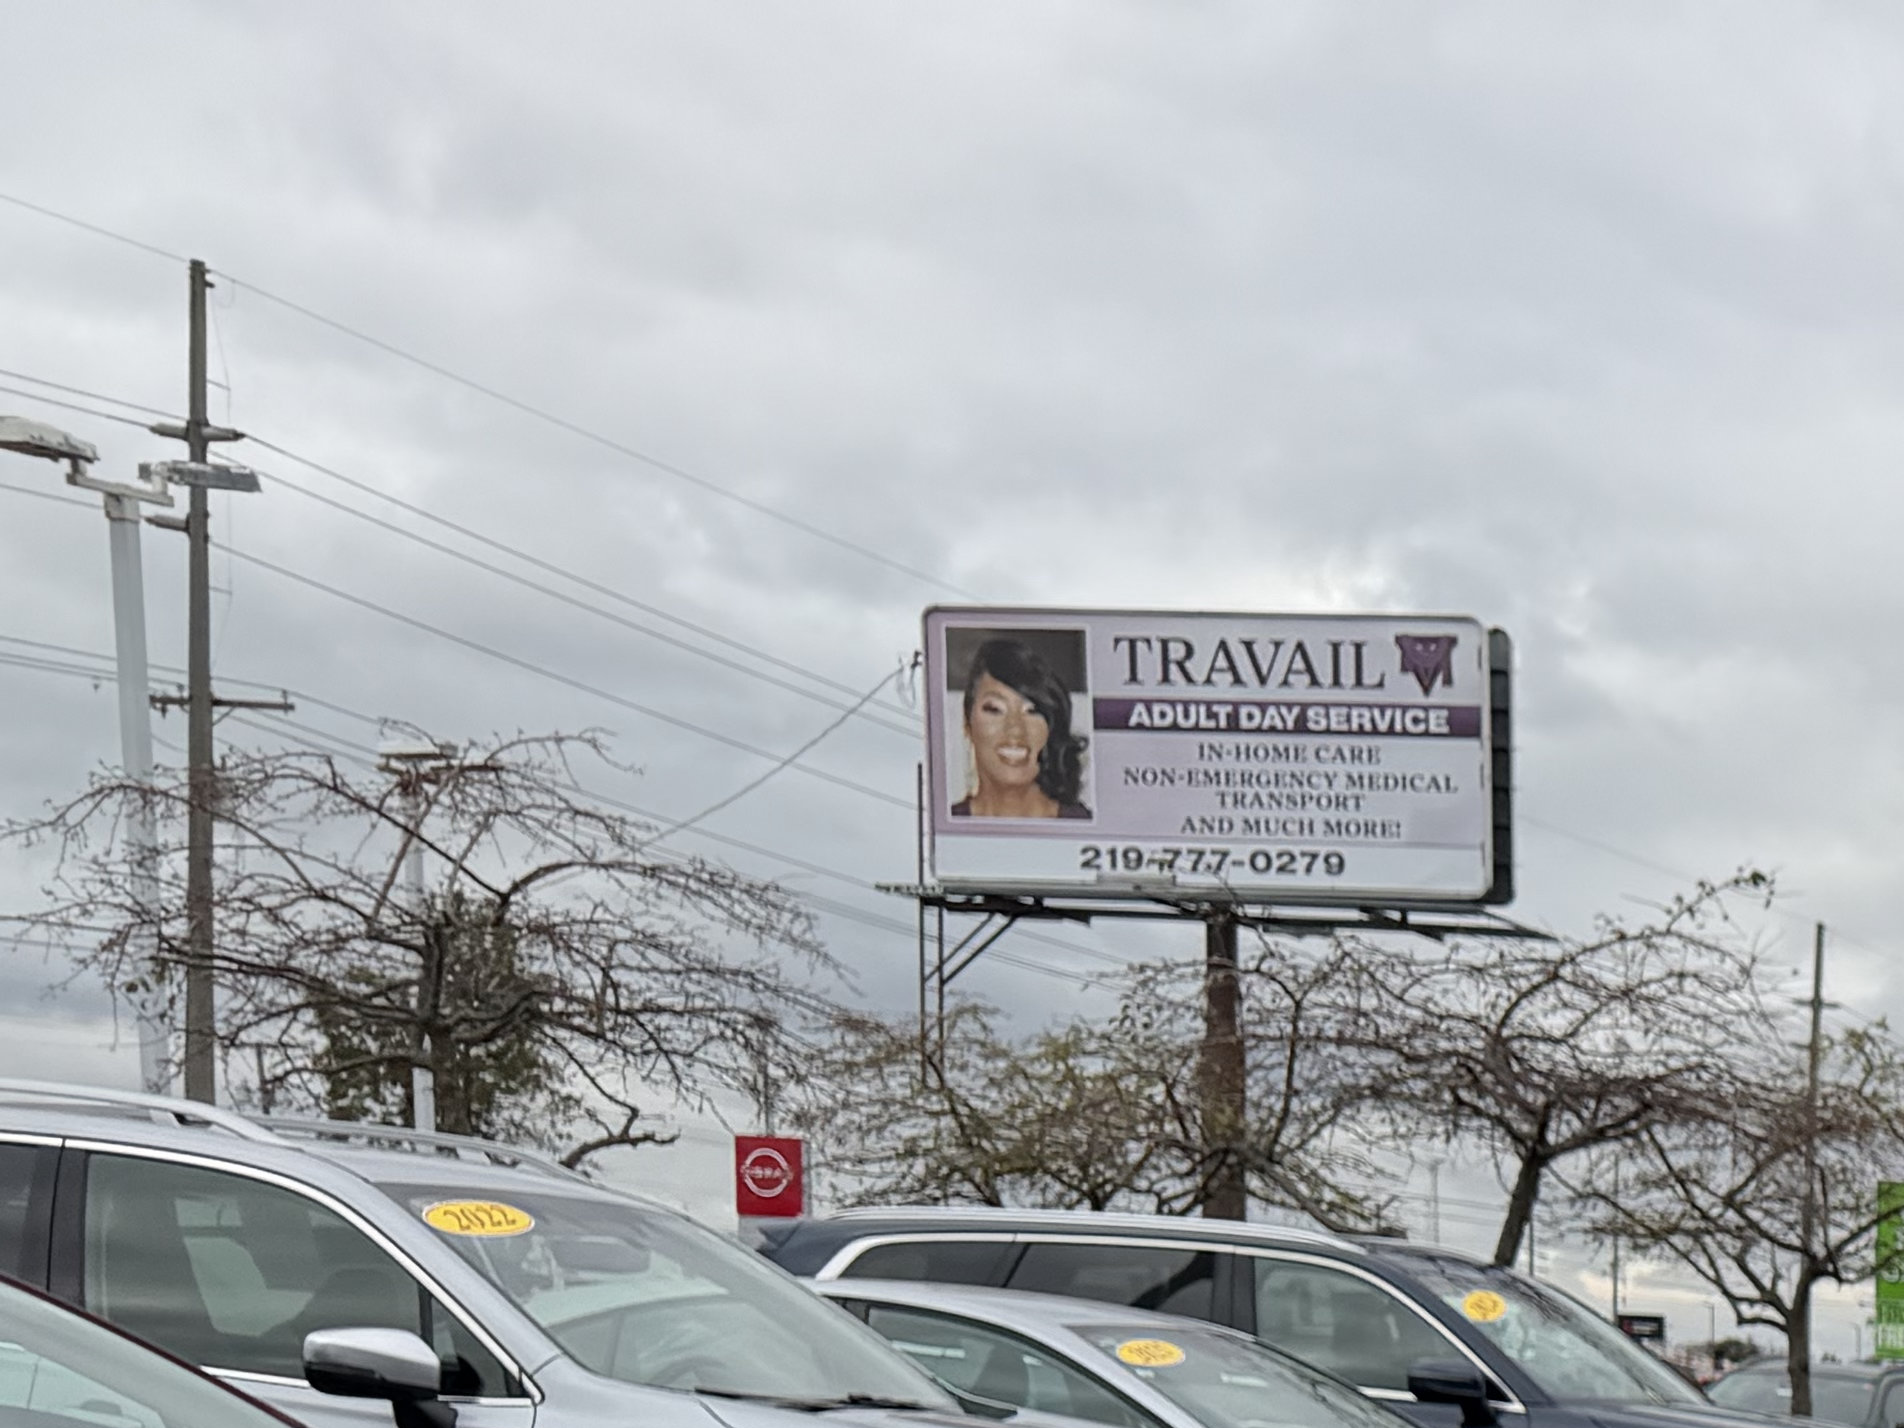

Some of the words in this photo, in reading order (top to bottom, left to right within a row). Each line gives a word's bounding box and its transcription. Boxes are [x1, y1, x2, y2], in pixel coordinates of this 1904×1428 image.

[1112, 636, 1386, 690] TRAVAIL
[1127, 702, 1233, 730] ADULT
[1239, 704, 1300, 731] DAY
[1306, 705, 1450, 735] SERVICE
[1198, 742, 1307, 764] IN-HOME
[1314, 744, 1382, 765] CARE
[1122, 766, 1338, 792] NON-EMERGENCY
[1344, 771, 1459, 794] MEDICAL
[1215, 789, 1366, 812] TRANSPORT
[1180, 815, 1235, 836] AND
[1241, 817, 1315, 837] MUCH
[1079, 844, 1347, 877] 219-777-0279
[442, 1203, 517, 1232] 2022
